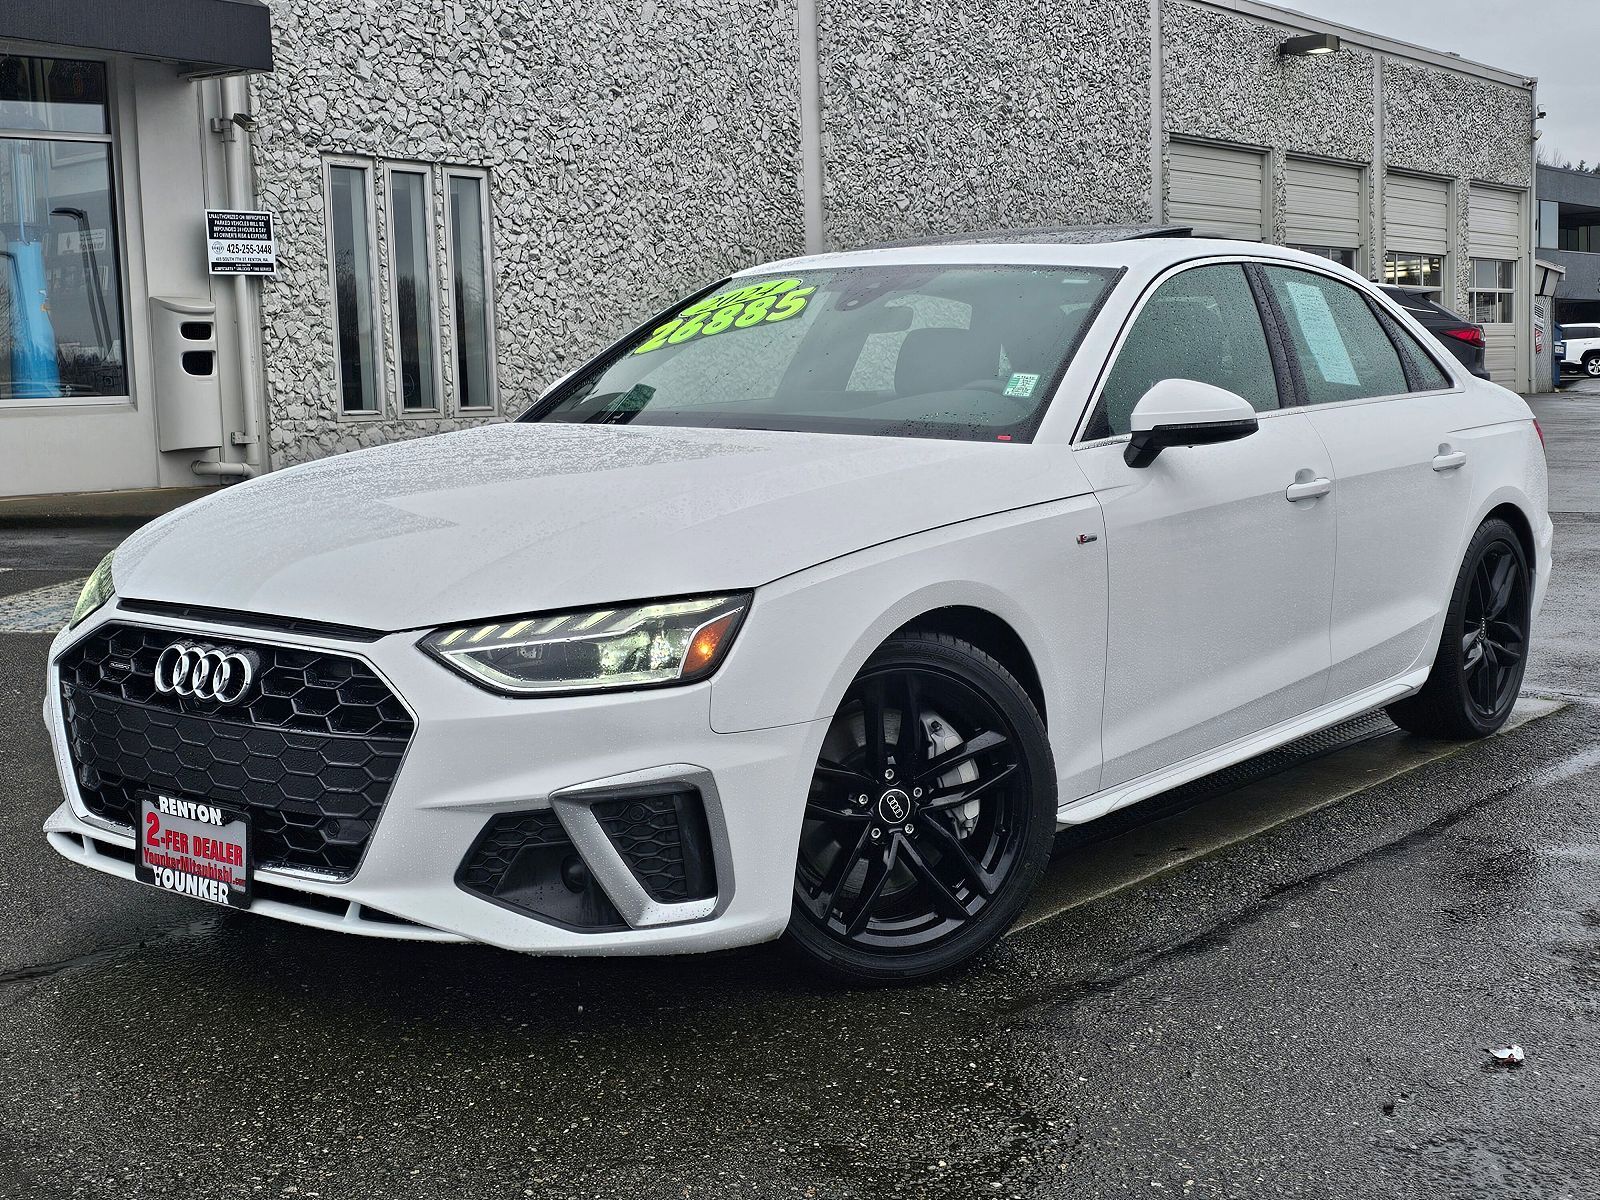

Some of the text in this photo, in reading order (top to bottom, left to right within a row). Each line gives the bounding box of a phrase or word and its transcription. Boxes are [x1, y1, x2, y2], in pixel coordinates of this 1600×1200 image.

[227, 244, 272, 254] 425-255-3448
[633, 285, 817, 356] 26885
[158, 795, 223, 826] RENTON
[146, 811, 243, 867] 2-FER DEALER
[152, 865, 229, 905] YOUNKER
